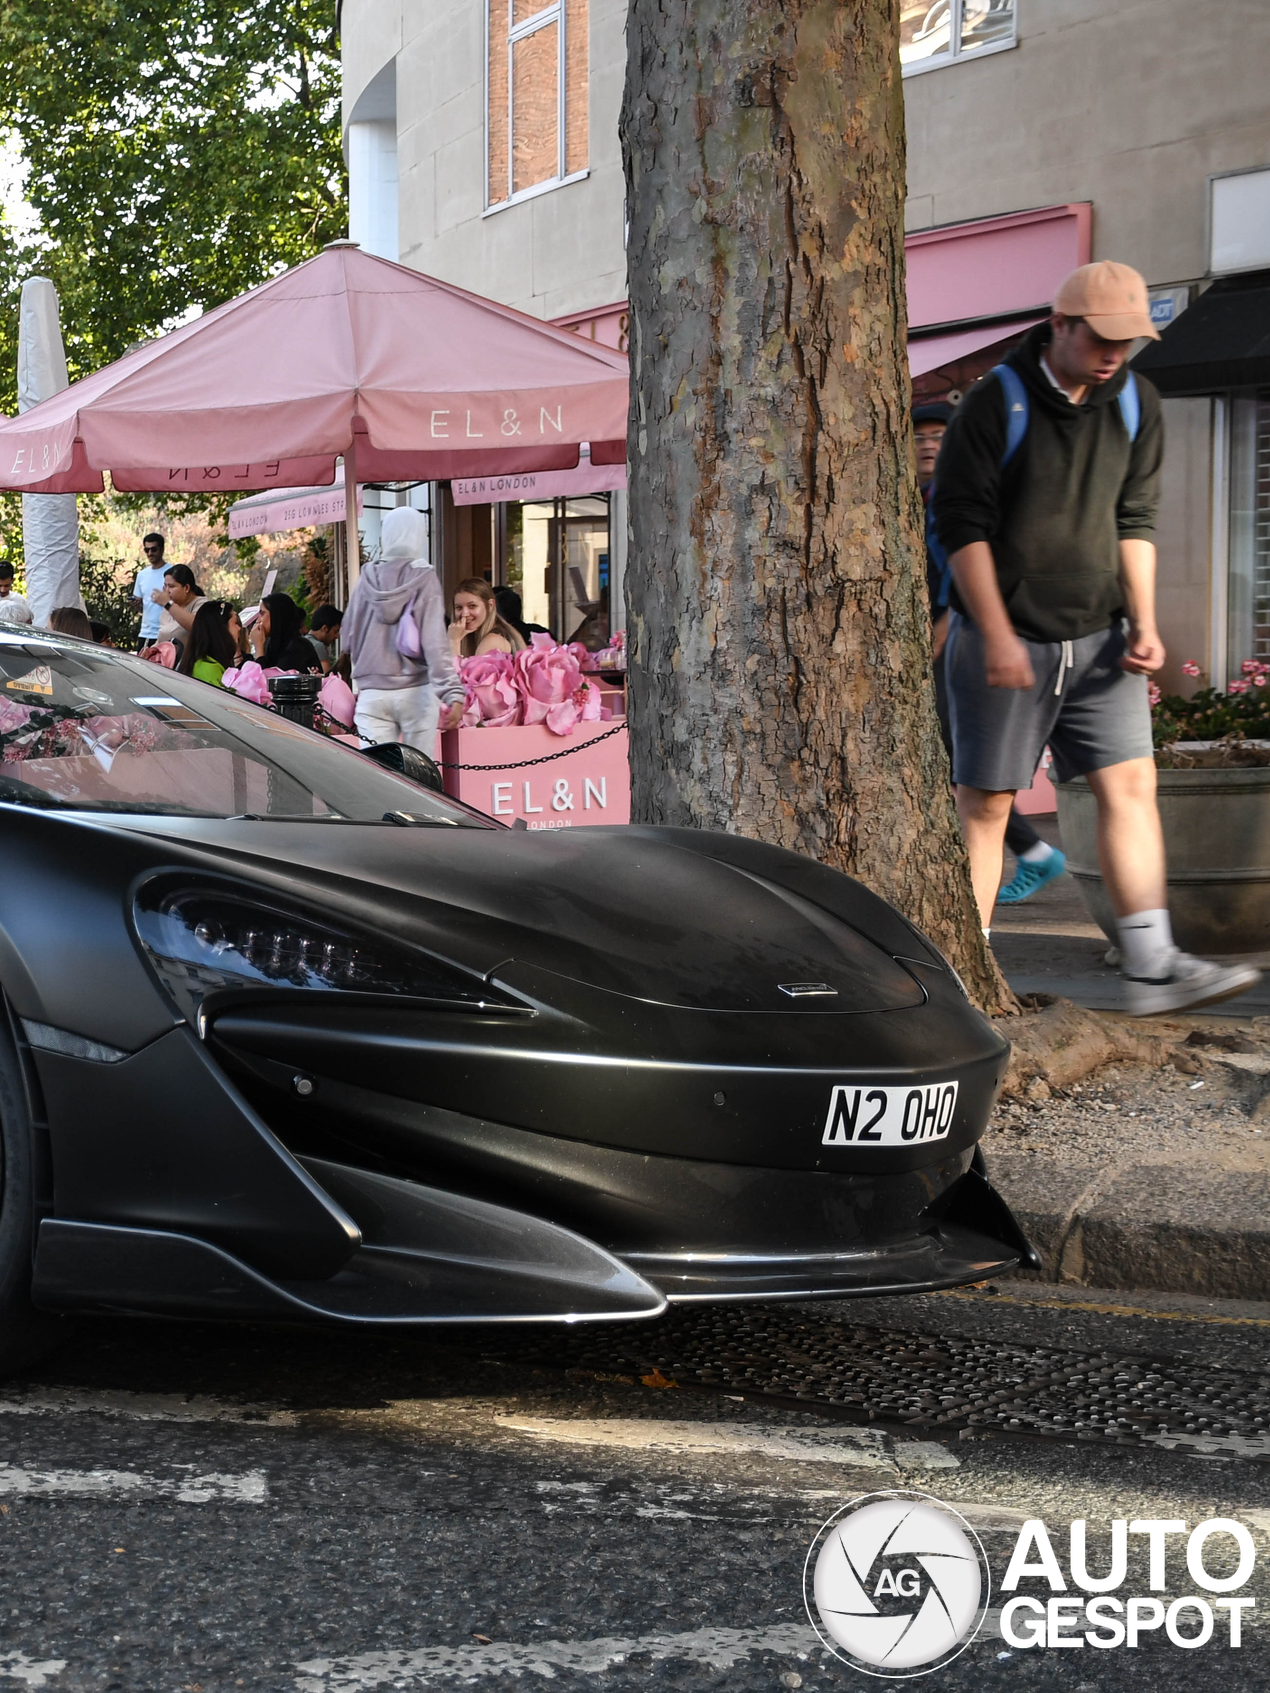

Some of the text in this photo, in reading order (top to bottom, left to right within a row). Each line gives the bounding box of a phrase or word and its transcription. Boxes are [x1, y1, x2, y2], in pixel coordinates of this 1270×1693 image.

[430, 405, 563, 438] EL&N
[458, 476, 536, 494] EL&N LONDON
[491, 776, 607, 815] EL&N
[828, 1089, 888, 1141] N2
